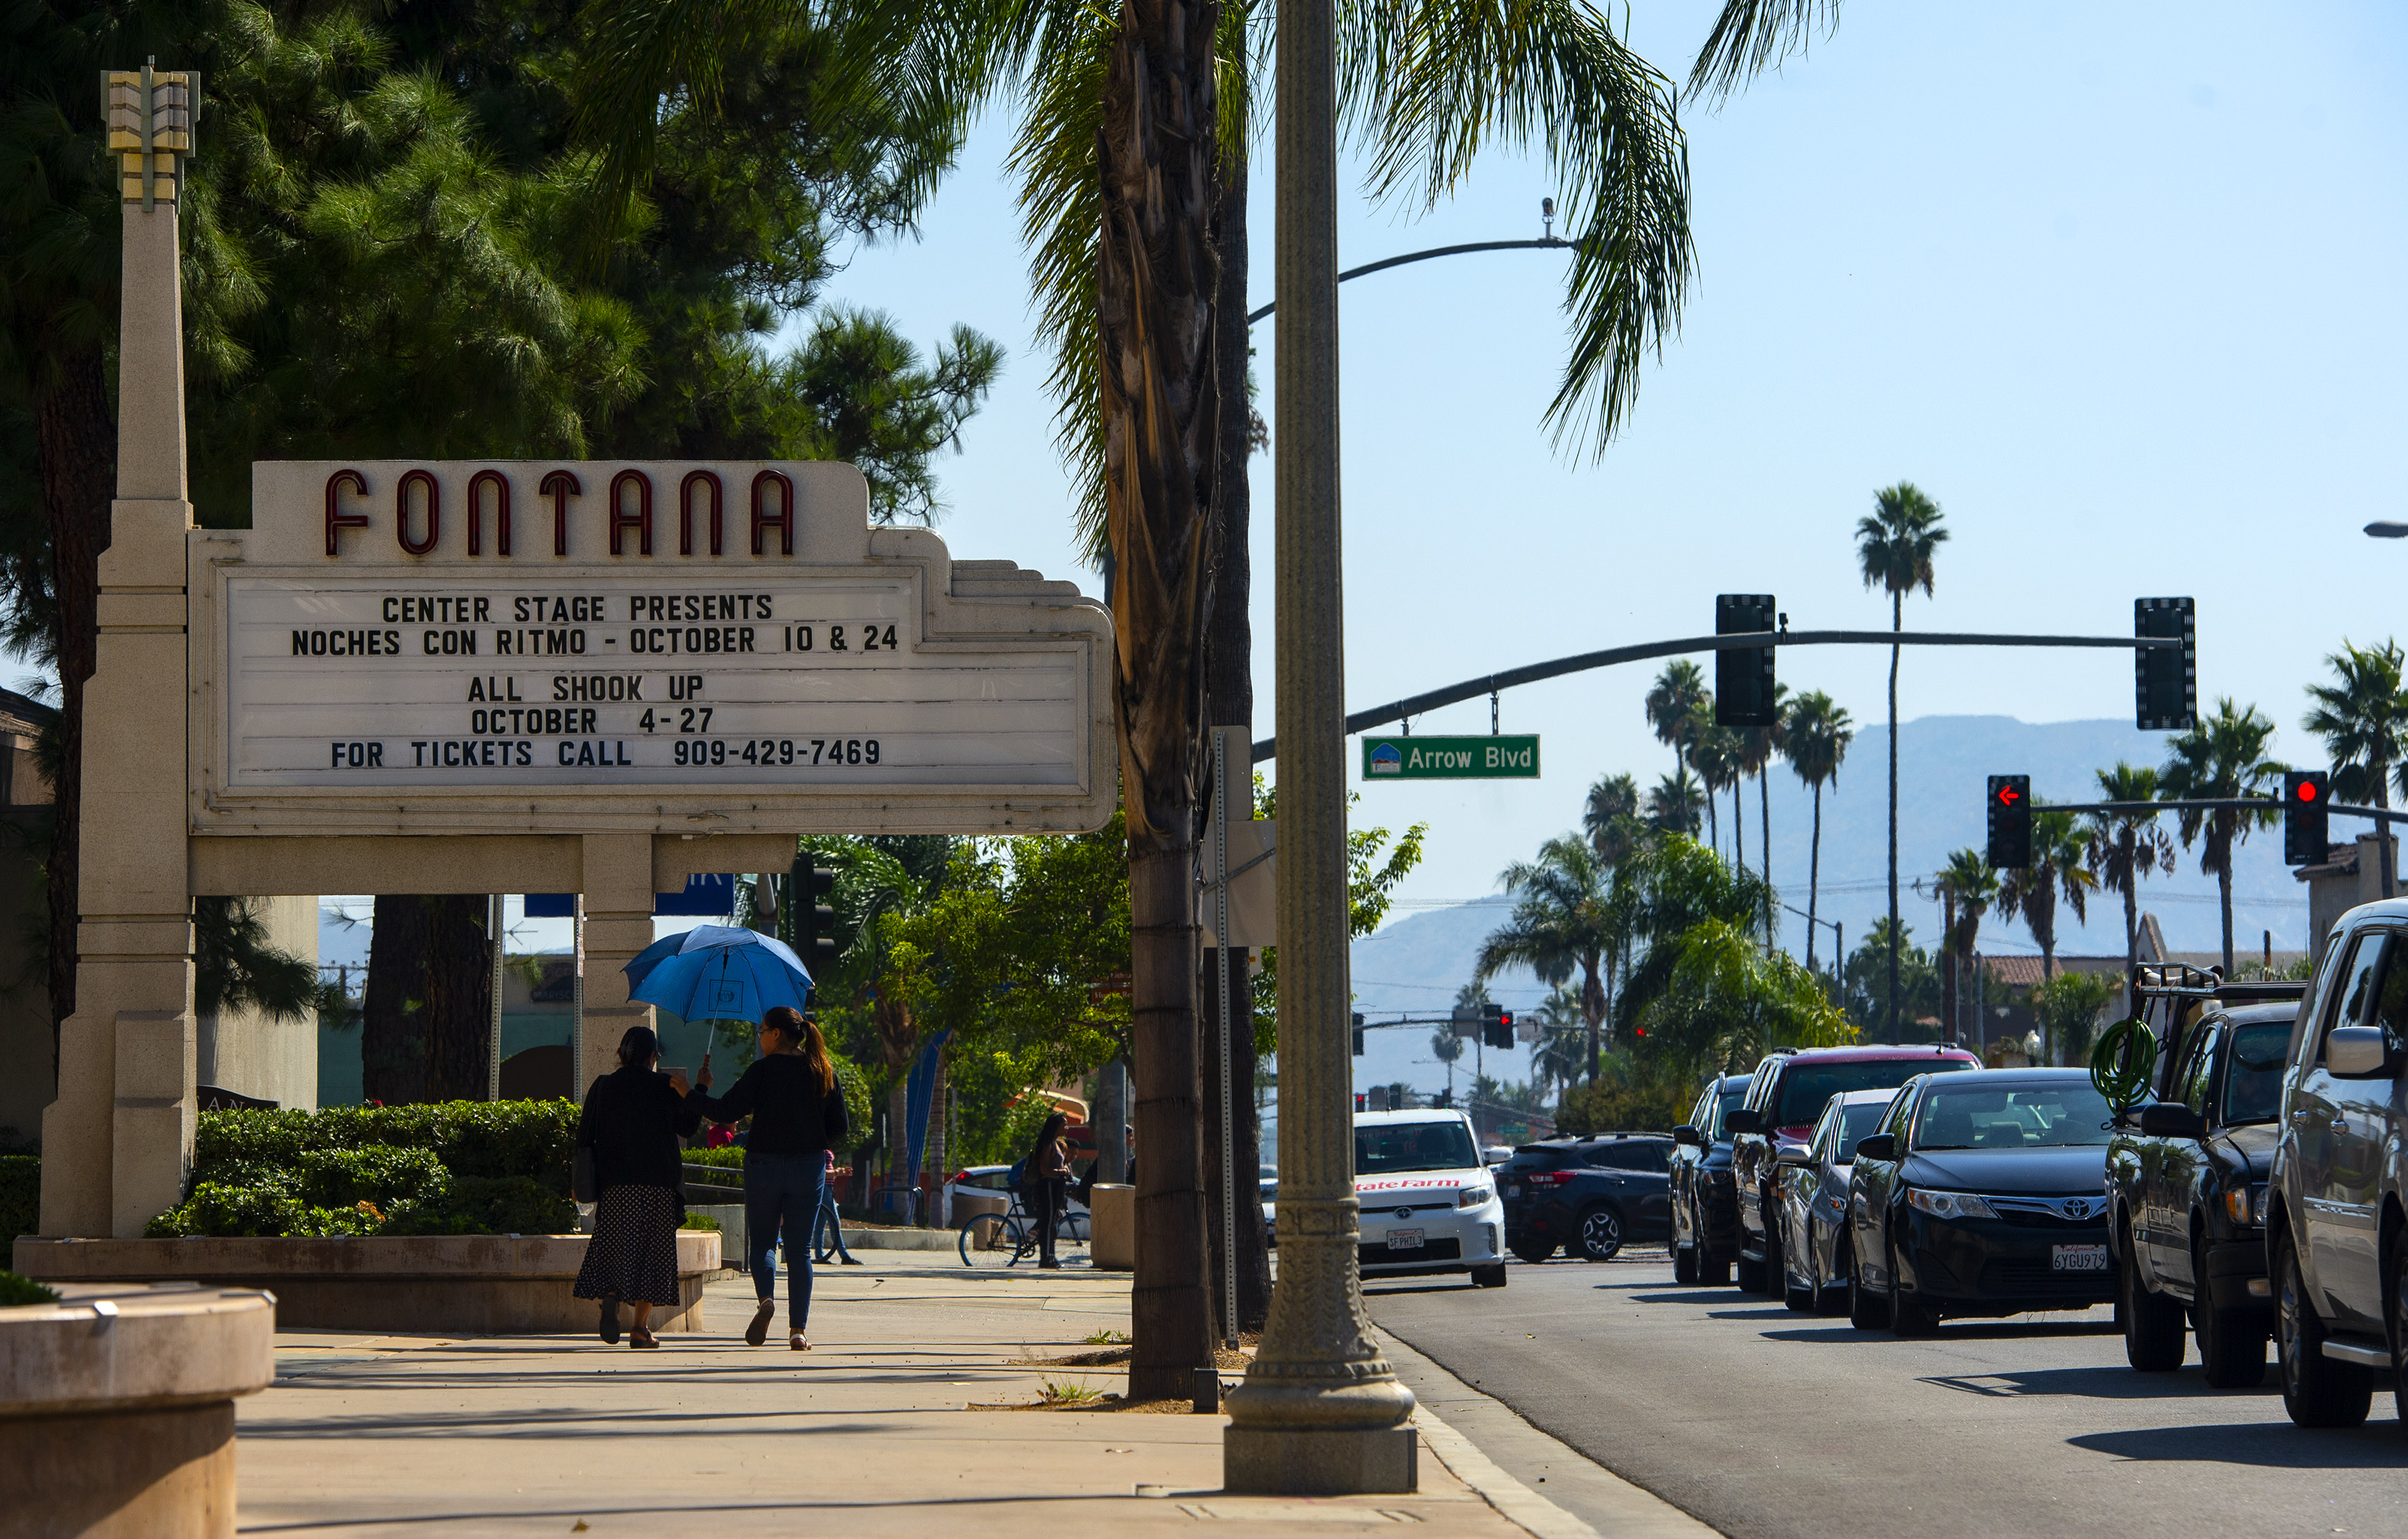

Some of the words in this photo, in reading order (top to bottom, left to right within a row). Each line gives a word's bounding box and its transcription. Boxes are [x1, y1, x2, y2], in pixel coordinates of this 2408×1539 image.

[324, 468, 793, 557] FONTANA
[383, 597, 489, 622] CENTER
[515, 596, 604, 622] STAGE
[631, 595, 771, 621] PRESENTS
[293, 630, 399, 655] NOCHES
[424, 630, 476, 655] CON
[497, 629, 585, 654] RITMO
[631, 628, 754, 653] OCTOBER
[785, 626, 812, 651] 10
[831, 626, 847, 650] &
[864, 625, 897, 650] 24
[468, 677, 522, 702] ALL
[554, 676, 642, 700] SHOOK
[670, 676, 702, 700] UP
[472, 709, 596, 734] OCTOBER
[640, 708, 712, 733] 4-27
[332, 742, 383, 767] FOR
[411, 741, 531, 766] TICKETS
[559, 741, 631, 766] CALL
[675, 740, 879, 765] 909-429-7469
[1408, 747, 1472, 769] Arrow
[1485, 746, 1532, 768] Blvd
[534, 990, 575, 1000] MARISC
[1355, 1182, 1399, 1191] tate
[2054, 1253, 2106, 1268] 6YGU979
[2061, 1244, 2098, 1254] California
